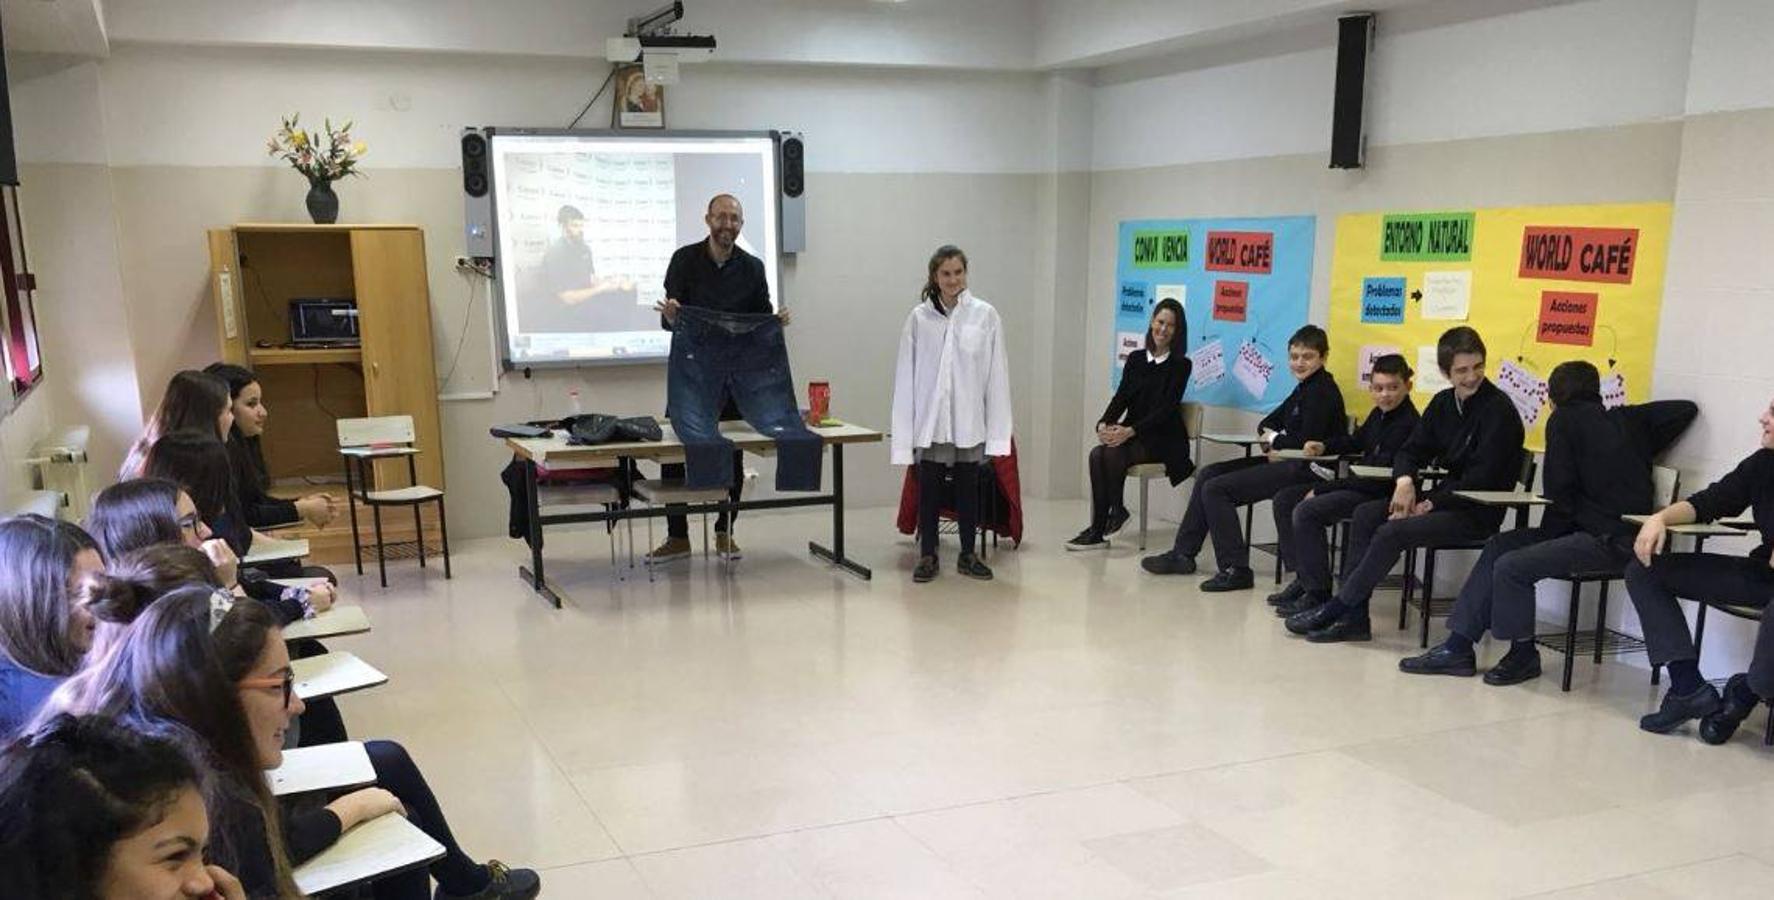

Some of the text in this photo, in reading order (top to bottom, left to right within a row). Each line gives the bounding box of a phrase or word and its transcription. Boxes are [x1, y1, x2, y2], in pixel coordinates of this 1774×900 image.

[1384, 219, 1469, 254] ENTORNO NATURAL
[1207, 236, 1270, 267] WORLD CAFÉ
[1525, 234, 1632, 275] WORLD CAFÉ
[1366, 284, 1403, 297] Problemas
[1364, 303, 1402, 317] detectados
[1550, 299, 1588, 314] Acciones
[1541, 321, 1590, 336] propuestas
